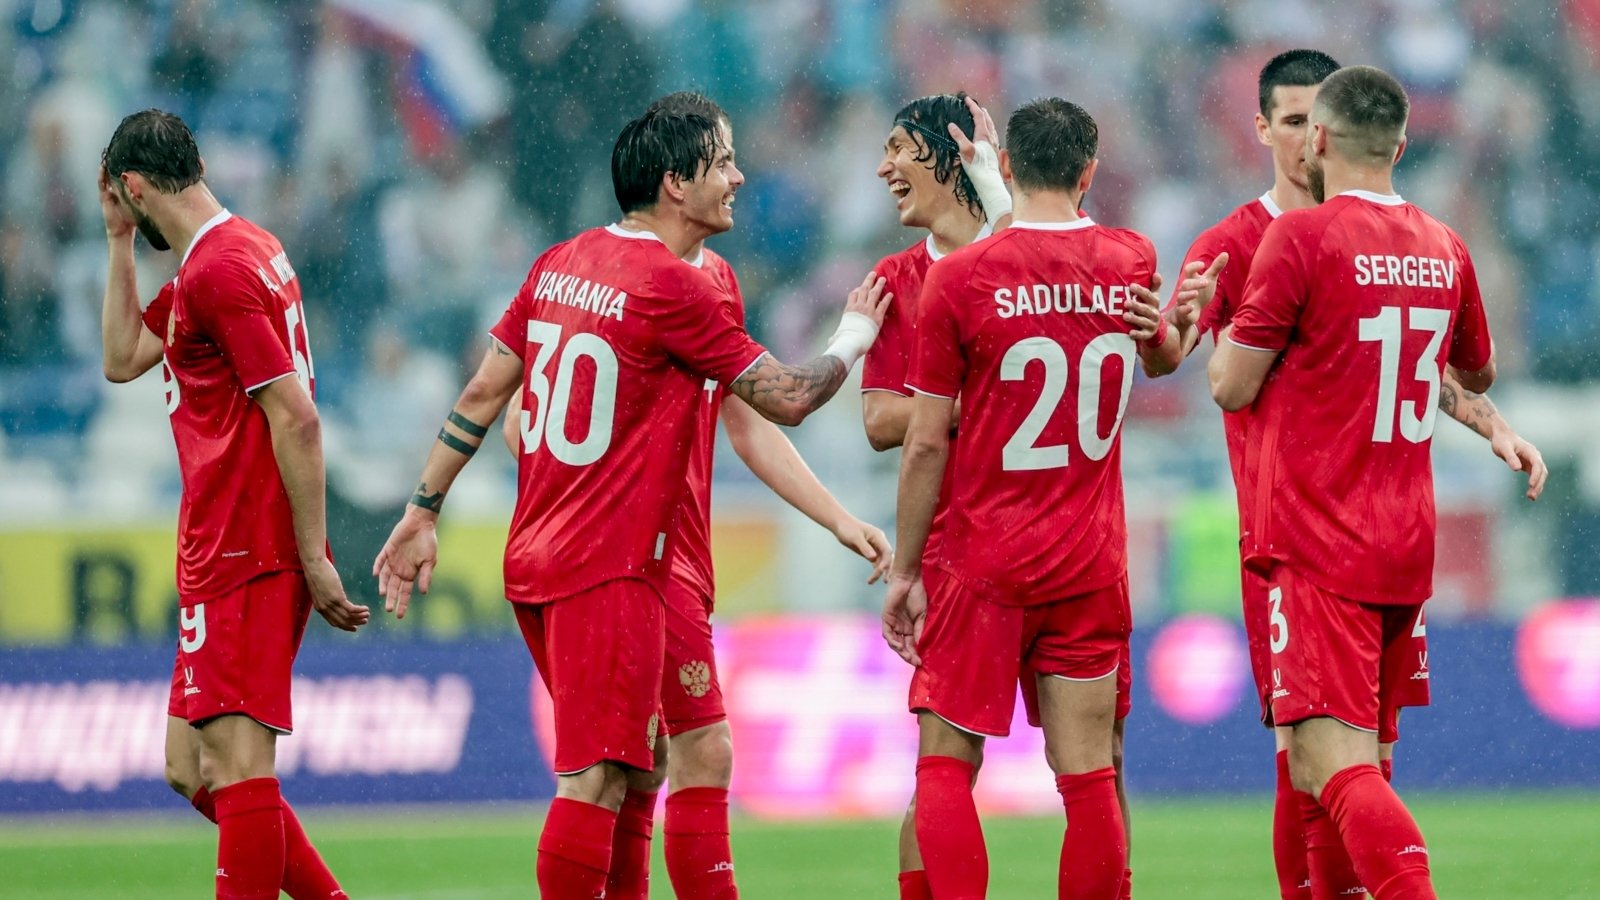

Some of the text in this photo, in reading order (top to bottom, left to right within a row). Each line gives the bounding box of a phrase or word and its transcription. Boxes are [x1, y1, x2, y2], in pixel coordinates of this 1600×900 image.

[533, 271, 627, 321] VAKHANIA
[1354, 254, 1454, 289] SERGEEV
[519, 320, 619, 467] 30
[999, 332, 1137, 471] 20
[1358, 306, 1451, 444] 13
[180, 602, 207, 654] 9
[1269, 586, 1289, 655] 3
